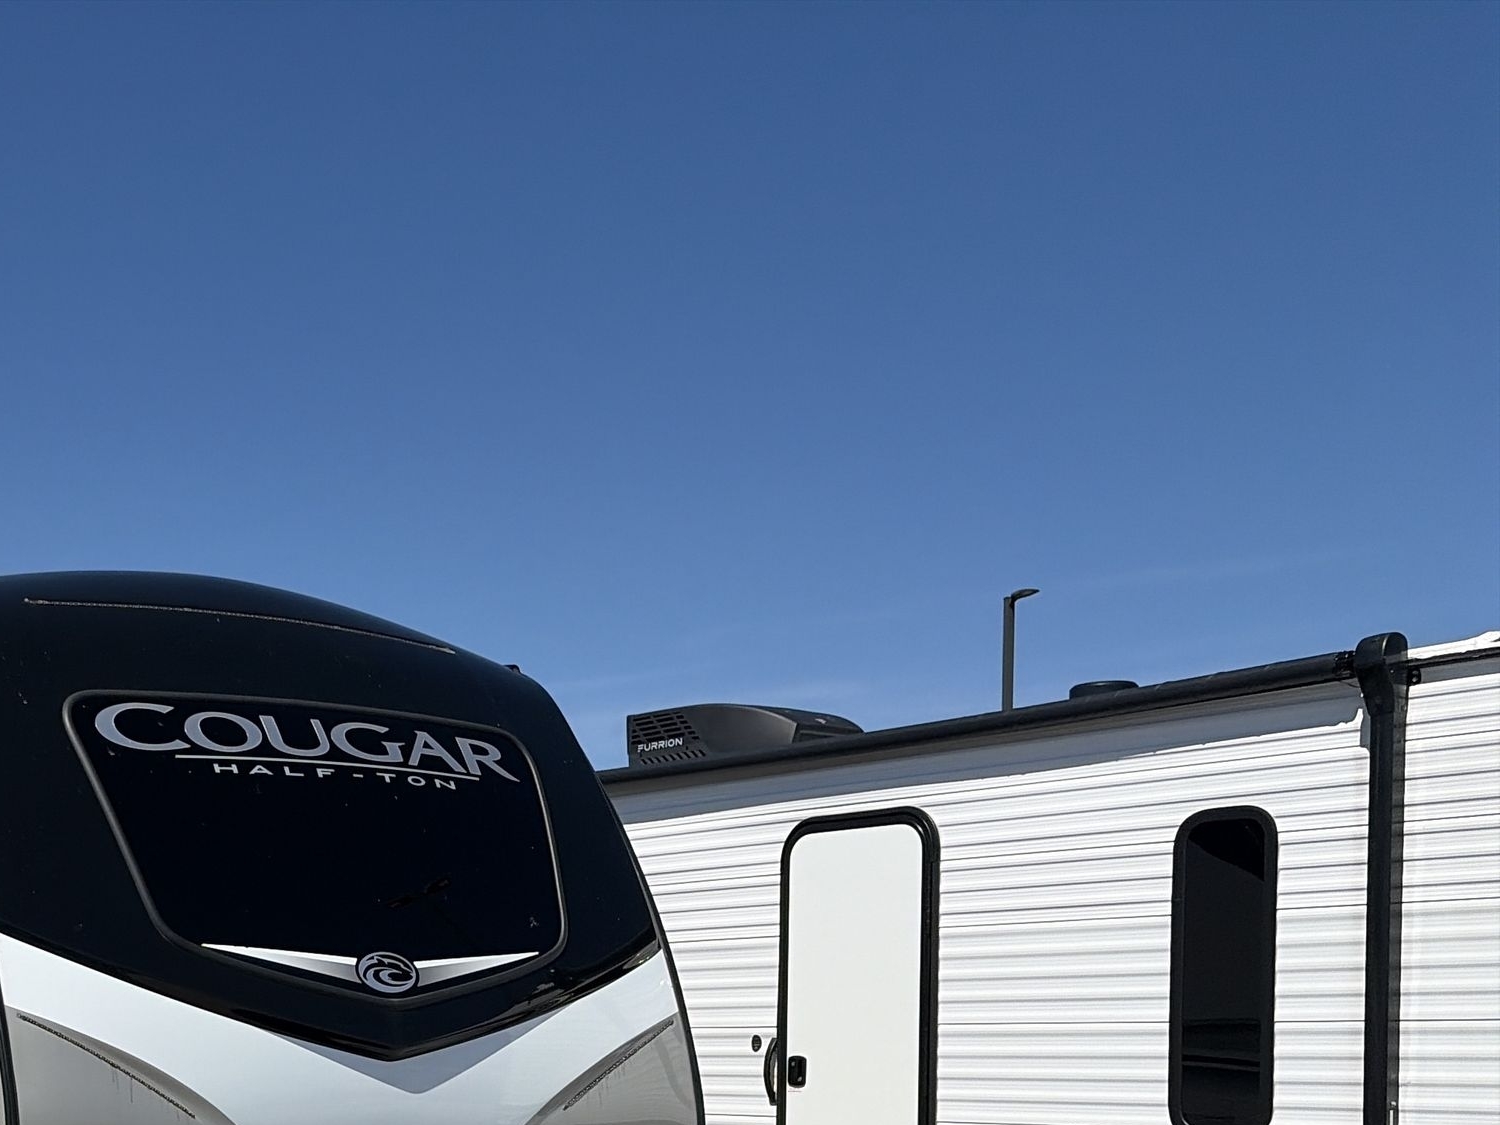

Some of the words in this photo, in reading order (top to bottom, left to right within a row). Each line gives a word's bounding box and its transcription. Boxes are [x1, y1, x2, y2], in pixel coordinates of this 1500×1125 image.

[94, 702, 520, 782] COUGAR
[637, 737, 683, 753] FURRION
[213, 762, 457, 790] HALF-TON
